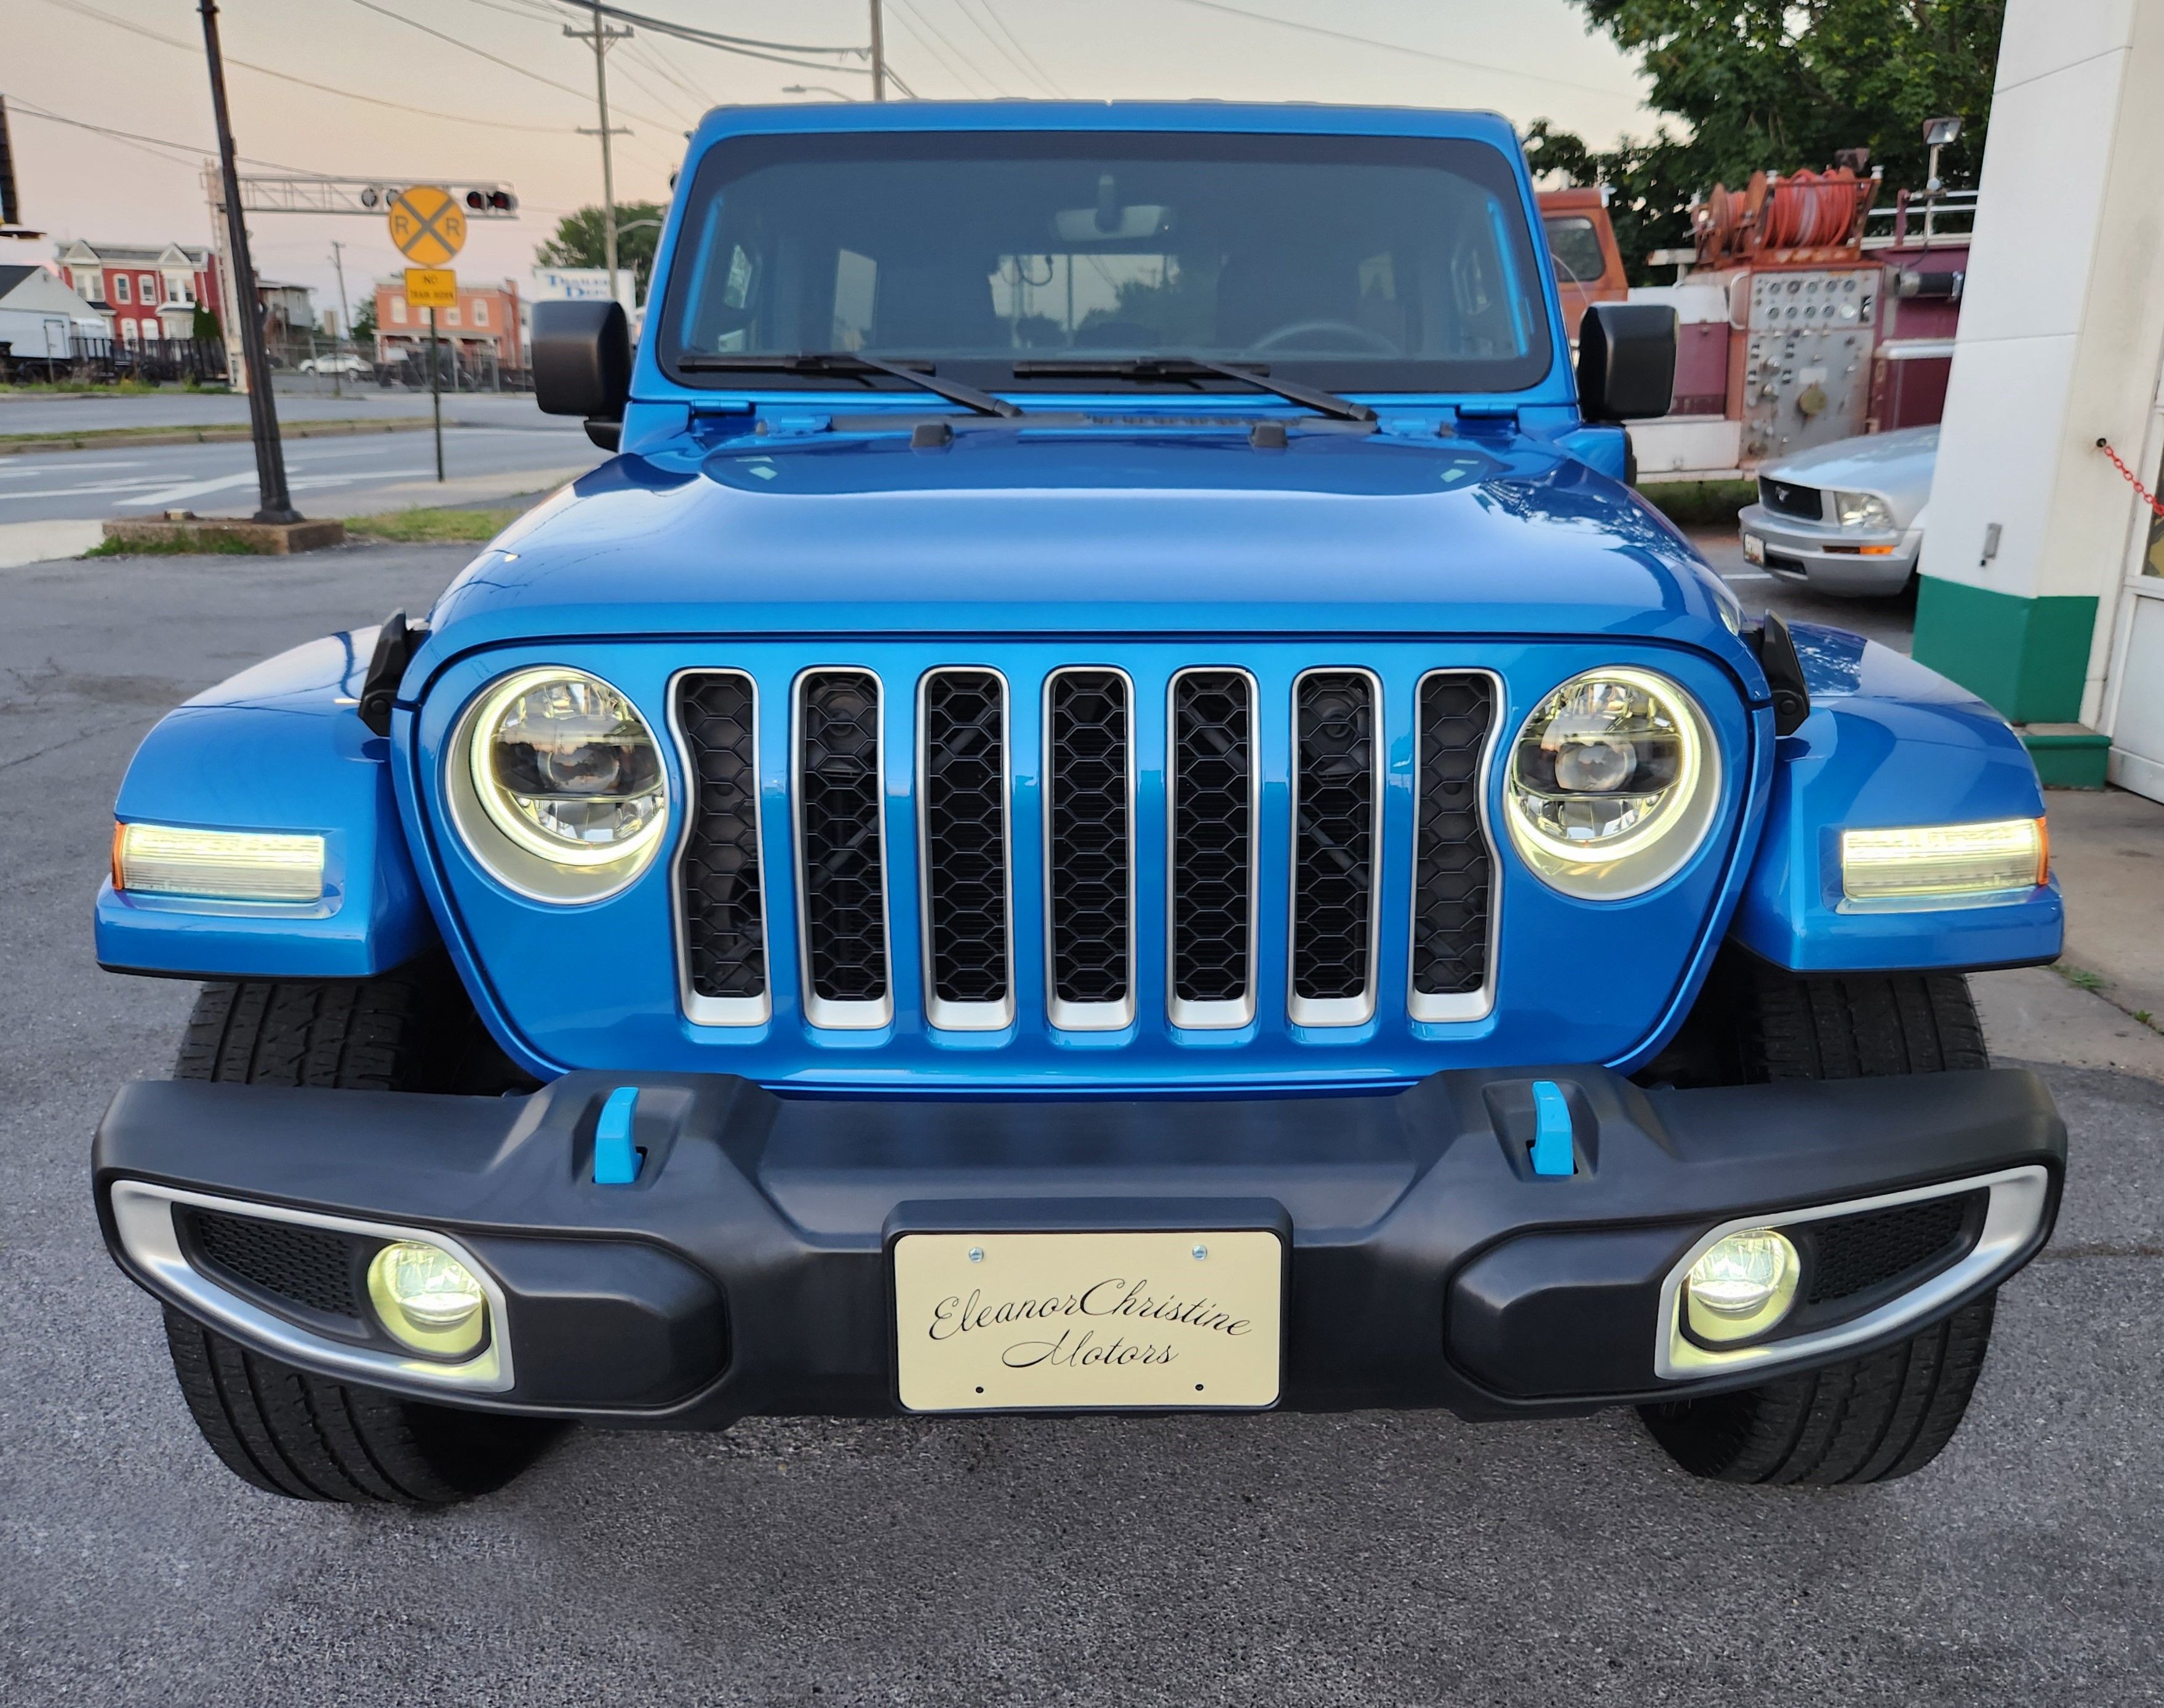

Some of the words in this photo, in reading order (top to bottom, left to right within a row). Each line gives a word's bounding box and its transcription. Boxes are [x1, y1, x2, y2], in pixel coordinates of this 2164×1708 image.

[395, 215, 409, 235] R
[446, 217, 460, 236] R
[423, 274, 438, 285] NO
[1001, 1328, 1180, 1368] Motors
